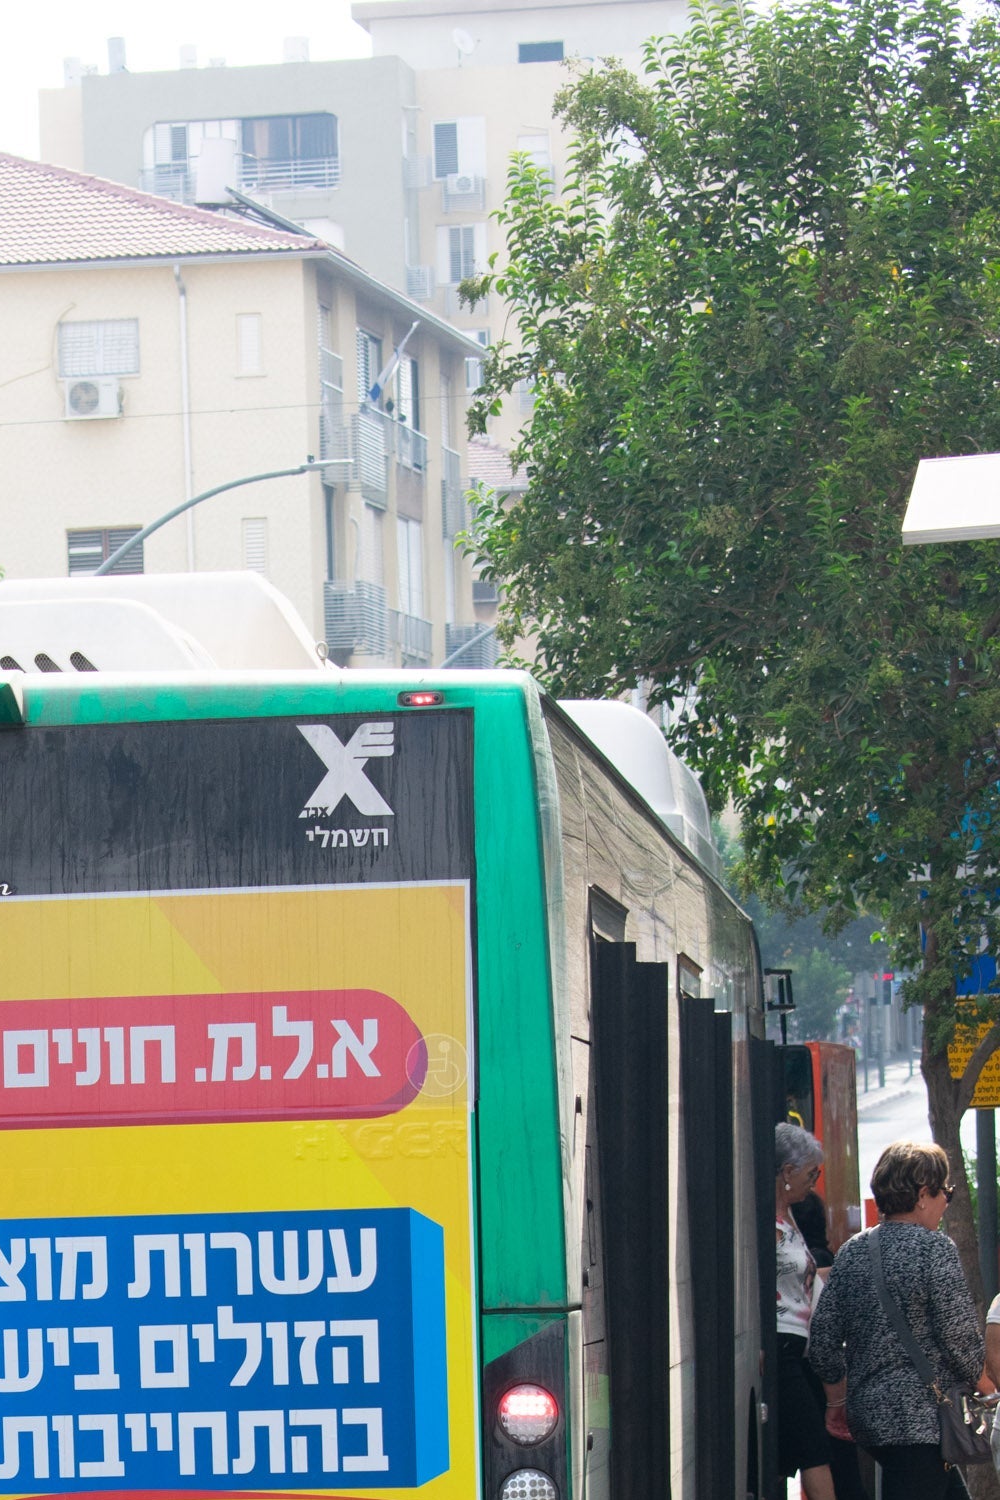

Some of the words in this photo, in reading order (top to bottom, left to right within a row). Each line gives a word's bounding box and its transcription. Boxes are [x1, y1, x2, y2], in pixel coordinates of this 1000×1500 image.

[306, 825, 389, 848] חשמלי
[3, 1024, 176, 1089] חונים
[195, 1006, 382, 1082] א.ל.מ.
[128, 1228, 377, 1298] עשרות
[139, 1306, 380, 1388] הזולים
